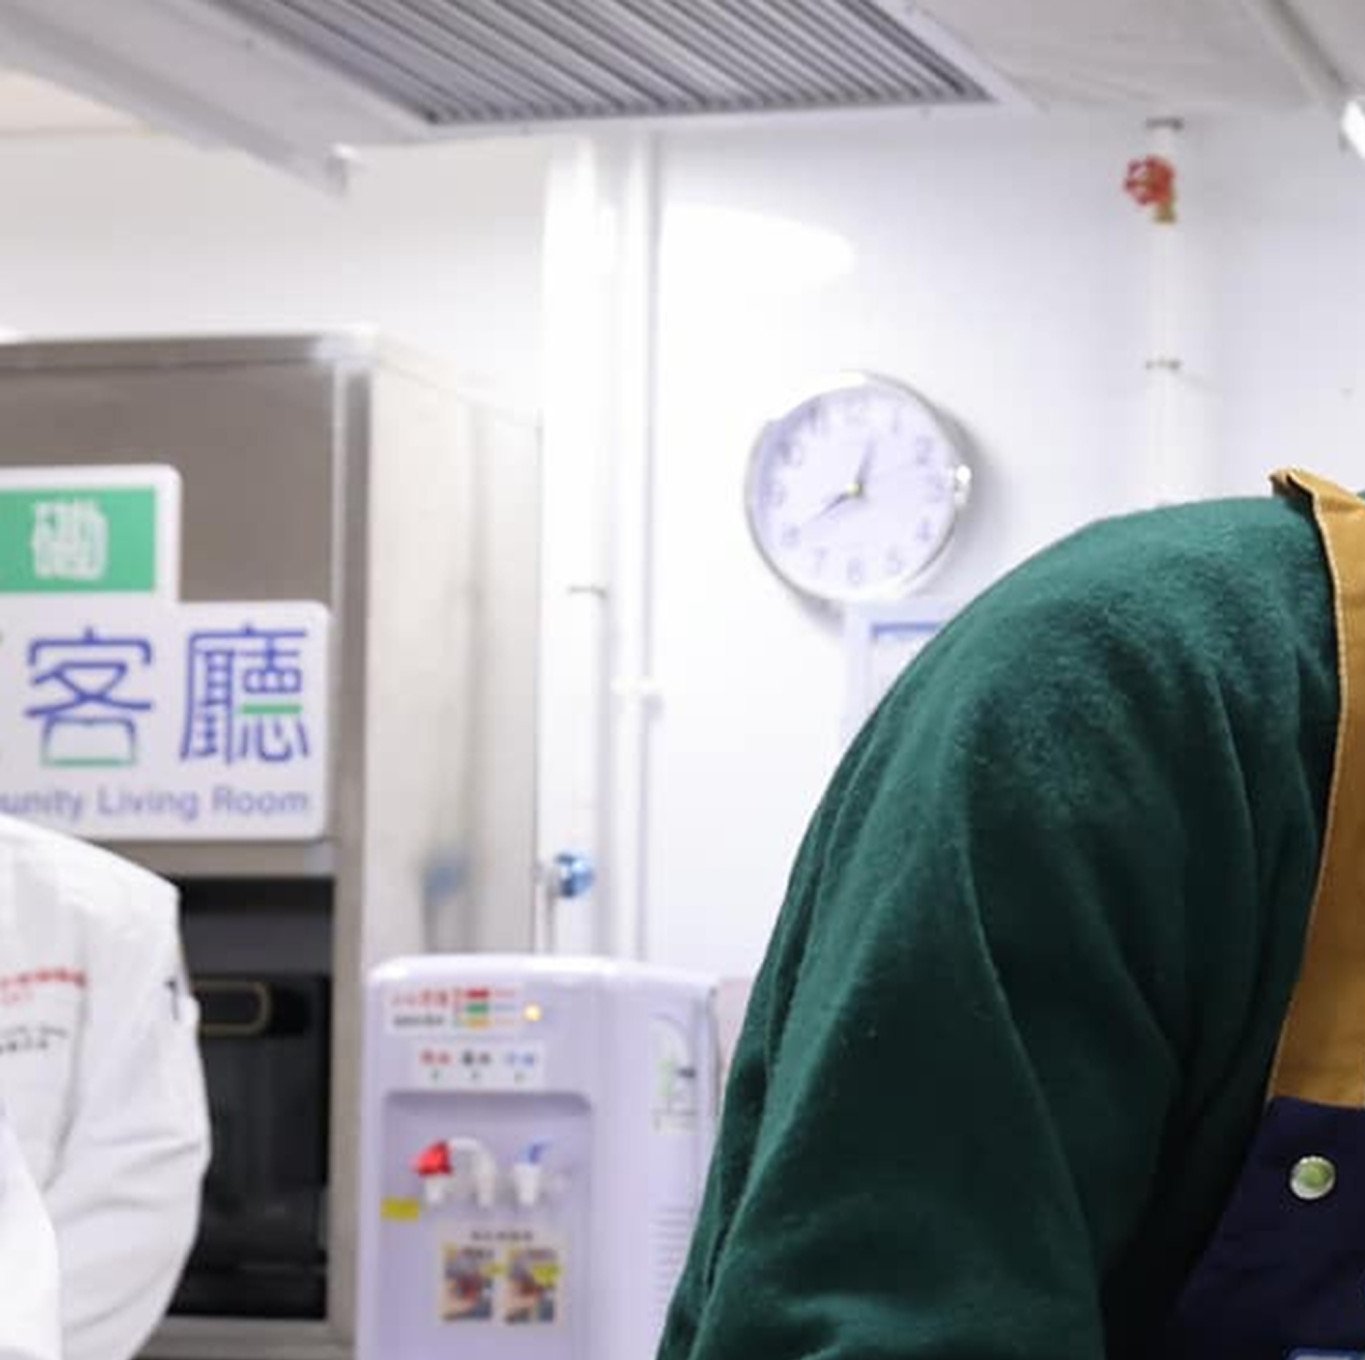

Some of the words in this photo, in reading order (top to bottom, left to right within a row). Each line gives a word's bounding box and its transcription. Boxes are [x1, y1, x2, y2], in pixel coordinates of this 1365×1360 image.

[24, 623, 310, 767] 客廳
[98, 784, 200, 822] Living
[212, 786, 309, 816] Room
